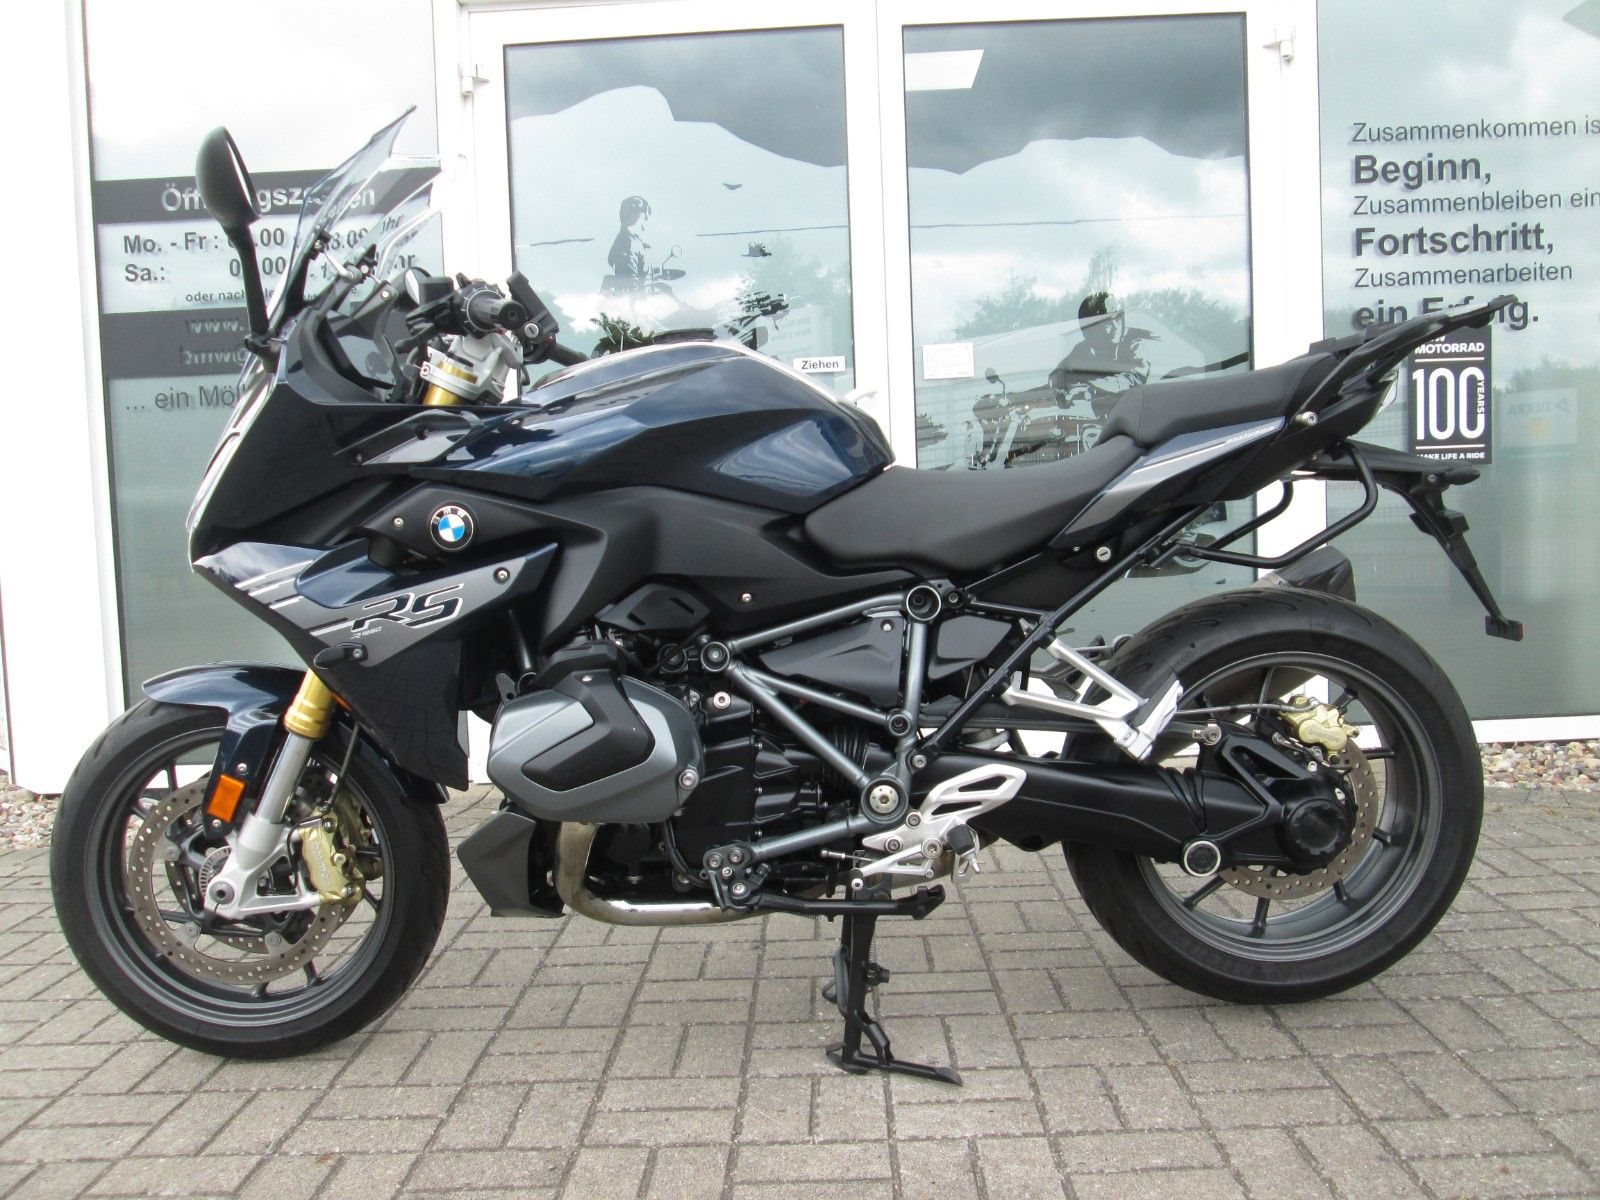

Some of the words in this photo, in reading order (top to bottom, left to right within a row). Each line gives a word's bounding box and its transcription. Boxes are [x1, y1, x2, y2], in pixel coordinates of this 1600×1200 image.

[1352, 119, 1577, 142] Zusammenkommen
[1354, 153, 1491, 190] Beginn,
[1353, 191, 1562, 215] Zusammenbleiben
[123, 234, 162, 253] Mo.
[1355, 222, 1554, 256] Fortschritt,
[124, 263, 165, 282] Sa.:
[1354, 263, 1573, 288] Zusammenarbeiten
[186, 291, 214, 302] oder
[1352, 299, 1408, 329] ein
[1414, 342, 1485, 354] MOTORRAD
[801, 360, 839, 370] Ziehen
[154, 387, 190, 410] ein
[1412, 366, 1485, 440] 100
[1477, 380, 1485, 414] YEARS
[1440, 452, 1458, 460] LIFE
[1458, 452, 1465, 460] A
[1466, 451, 1485, 459] RIDE
[350, 583, 464, 632] RS
